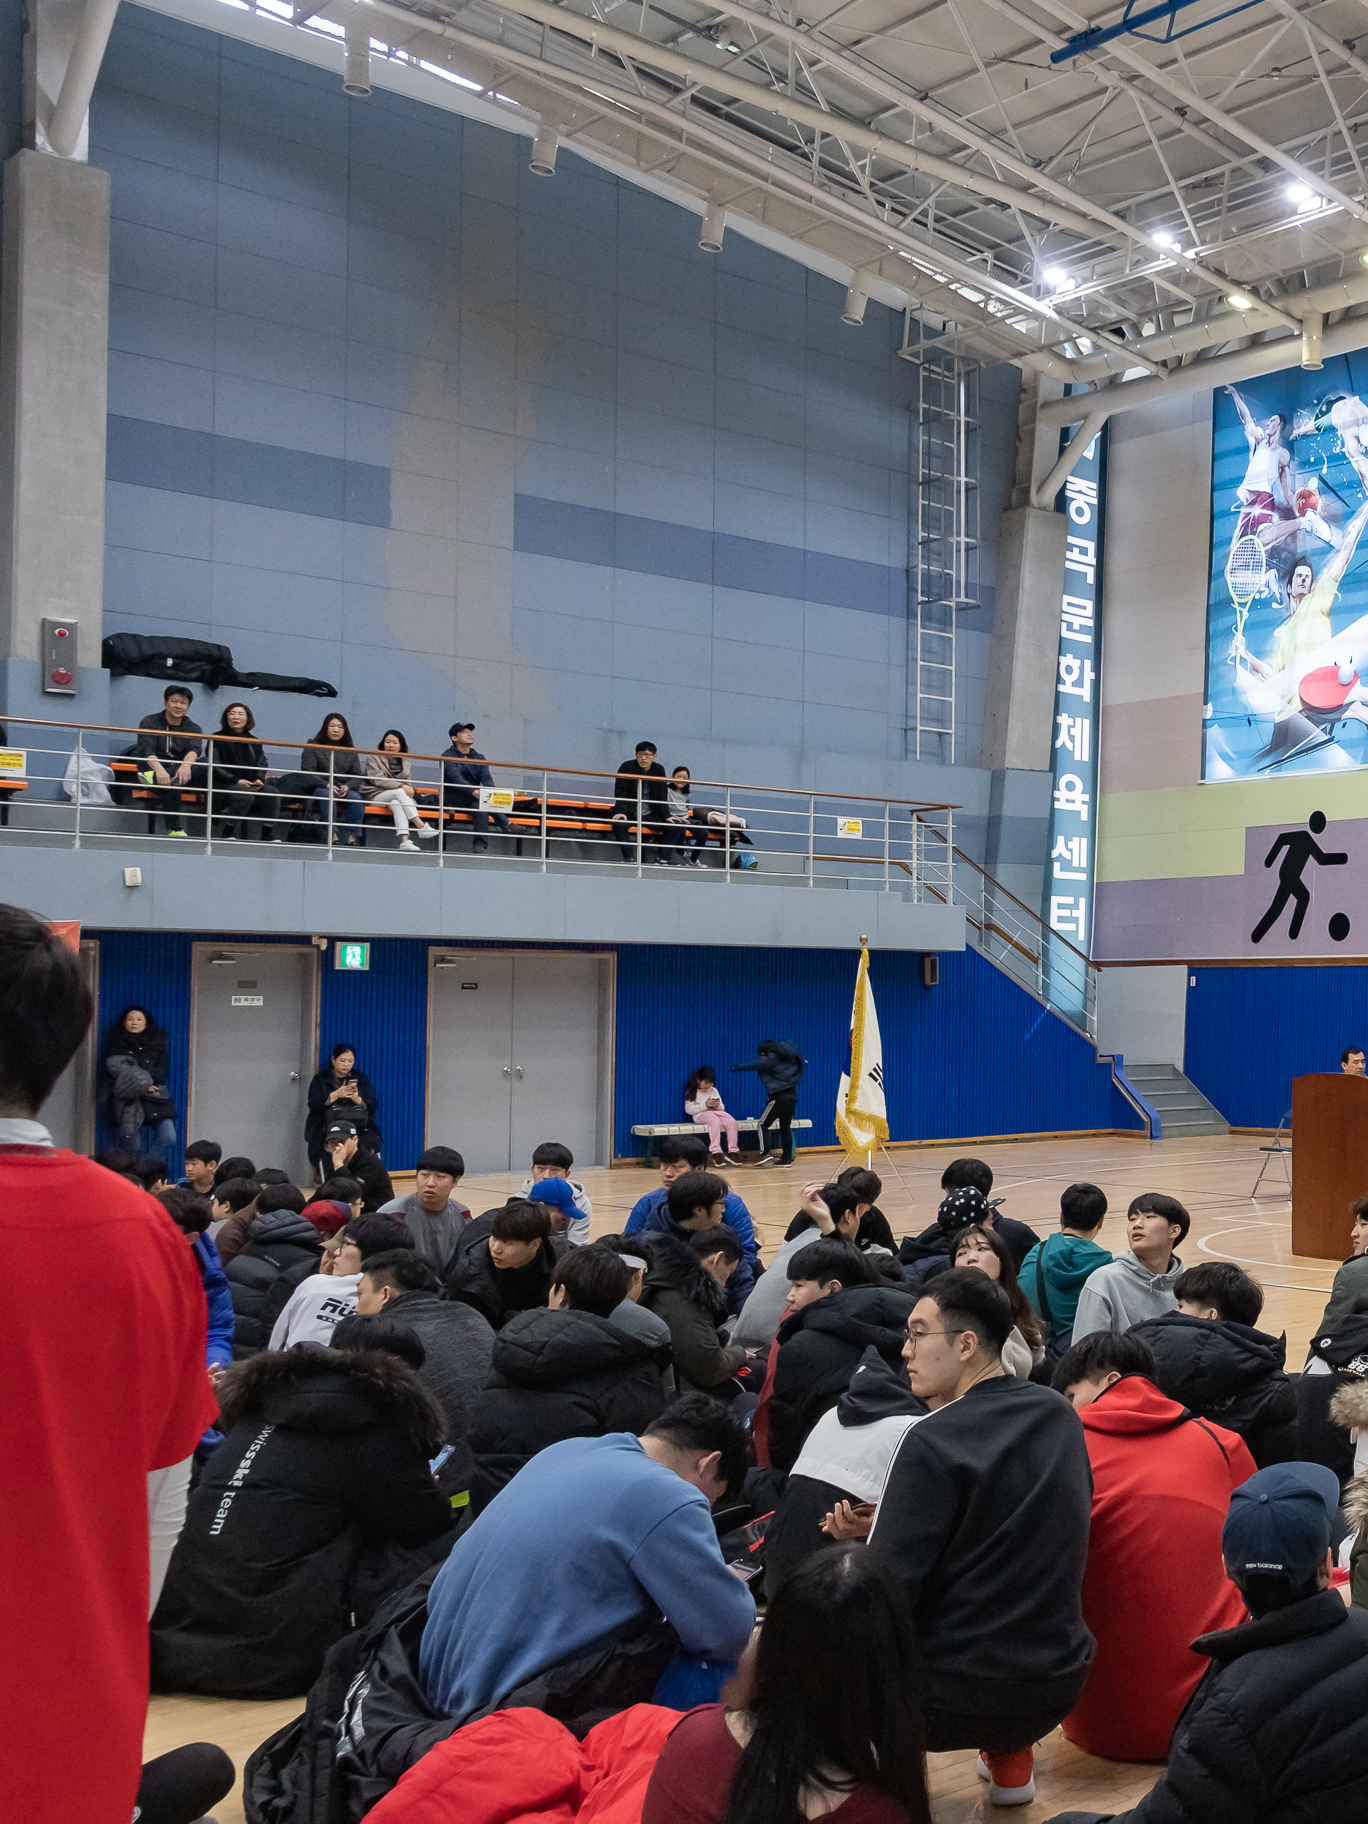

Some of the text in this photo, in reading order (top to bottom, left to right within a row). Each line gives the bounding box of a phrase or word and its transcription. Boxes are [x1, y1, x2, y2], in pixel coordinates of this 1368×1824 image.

[1049, 474, 1098, 941] 중곡문화체육센터
[209, 1491, 236, 1535] team
[1257, 1562, 1283, 1570] balance
